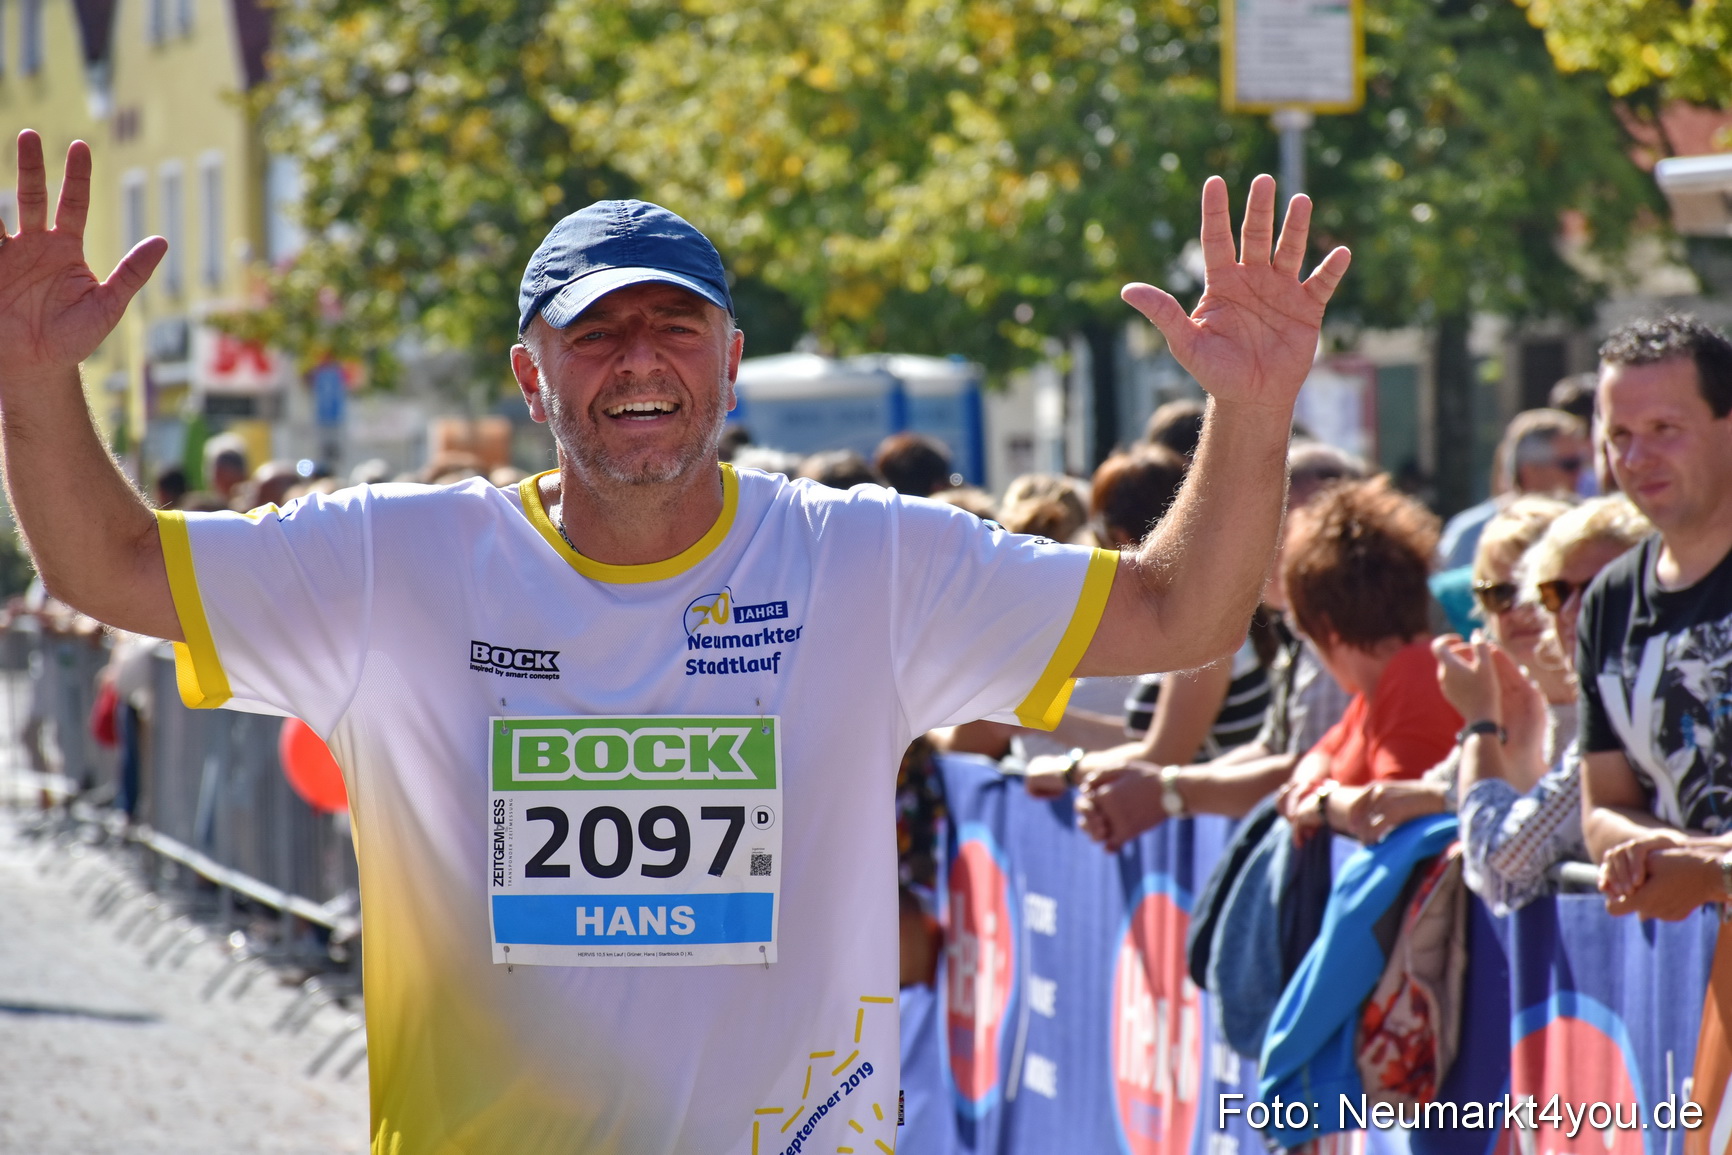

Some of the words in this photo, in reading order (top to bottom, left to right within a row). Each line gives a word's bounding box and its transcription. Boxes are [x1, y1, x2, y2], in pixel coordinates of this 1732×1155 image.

[691, 592, 730, 633] 20
[738, 604, 784, 623] JAHRE
[687, 624, 804, 651] Neumarkter
[469, 663, 494, 674] inspired
[495, 667, 504, 677] by
[505, 671, 528, 679] smart
[529, 672, 560, 681] concepts
[470, 640, 560, 672] BOCK
[685, 651, 782, 676] Stadtlauf
[512, 727, 758, 782] BOCK
[757, 811, 769, 825] D
[524, 805, 746, 879] 2097
[575, 905, 696, 937] HANS
[779, 1091, 845, 1155] eptember
[839, 1061, 874, 1096] 2019
